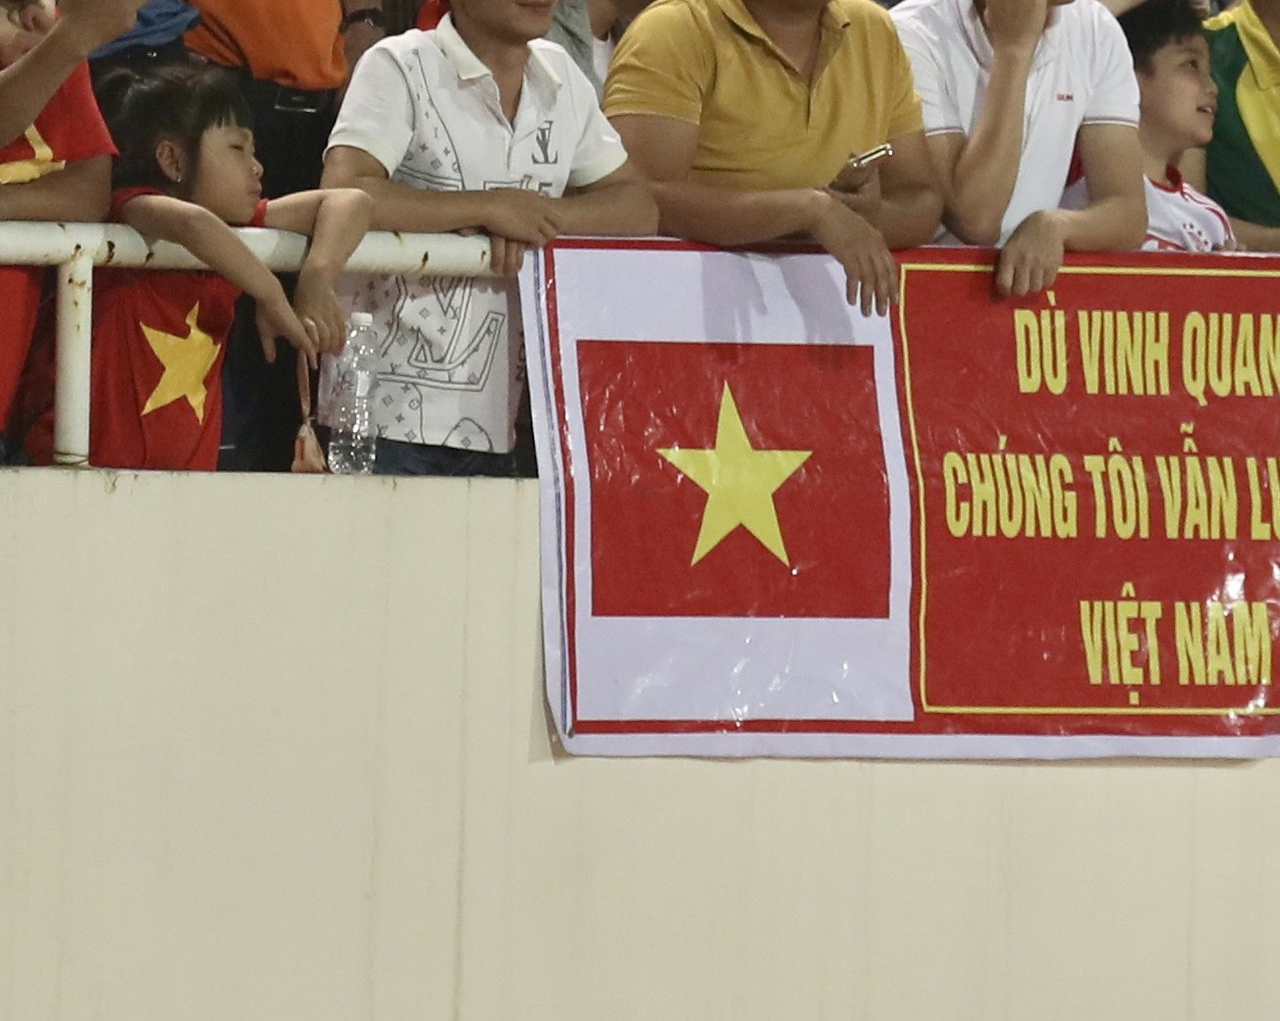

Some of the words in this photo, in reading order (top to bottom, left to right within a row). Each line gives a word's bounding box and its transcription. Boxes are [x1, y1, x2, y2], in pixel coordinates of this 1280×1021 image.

[1014, 290, 1068, 395] DÙ
[1077, 310, 1170, 396] VINH
[943, 435, 1078, 539] CHÚNG
[1083, 437, 1149, 540] TÔI
[1154, 422, 1238, 540] VẪN
[1079, 581, 1162, 705] VIỆT
[1174, 599, 1272, 686] NAM
